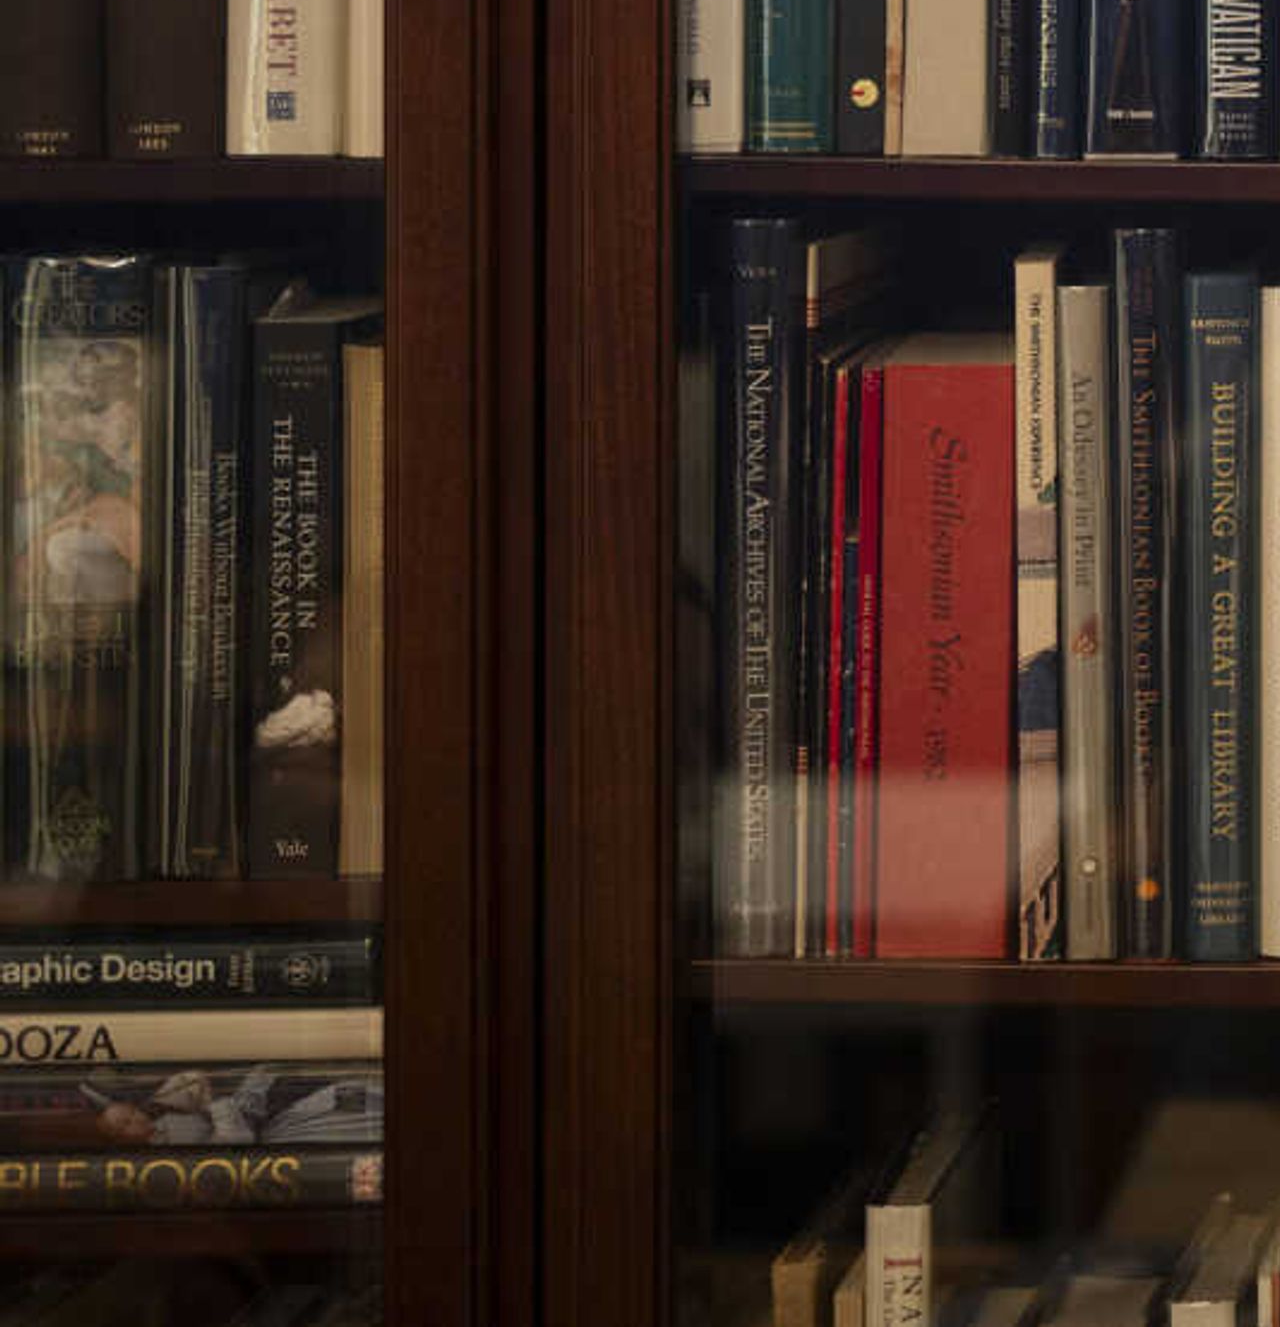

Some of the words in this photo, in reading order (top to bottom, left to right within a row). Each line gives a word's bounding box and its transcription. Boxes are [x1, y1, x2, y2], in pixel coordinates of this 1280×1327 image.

[746, 316, 774, 364] THE
[1134, 330, 1158, 379] THE
[1073, 374, 1095, 404] An
[273, 415, 294, 471] THE
[746, 369, 772, 488] NATIONAL
[1069, 410, 1096, 499] Odyssey
[212, 452, 237, 512] Books
[301, 451, 318, 497] THE
[1133, 387, 1156, 570] SMITHSONIAN
[1211, 381, 1238, 538] BUILDING
[746, 491, 771, 603] ARCHIVES
[1073, 507, 1095, 529] in
[270, 476, 293, 667] RENAISSANCE
[300, 511, 317, 593] BOOK
[1073, 534, 1095, 588] Print
[1211, 552, 1238, 576] A
[299, 601, 316, 629] IN
[1132, 576, 1157, 641] BOOK
[746, 644, 770, 687] THE
[928, 630, 966, 696] Year
[1211, 592, 1238, 692] GREAT
[746, 692, 769, 782] UNITED
[1210, 709, 1237, 842] LIBRARY
[276, 842, 309, 859] Yale
[100, 954, 215, 989] Design
